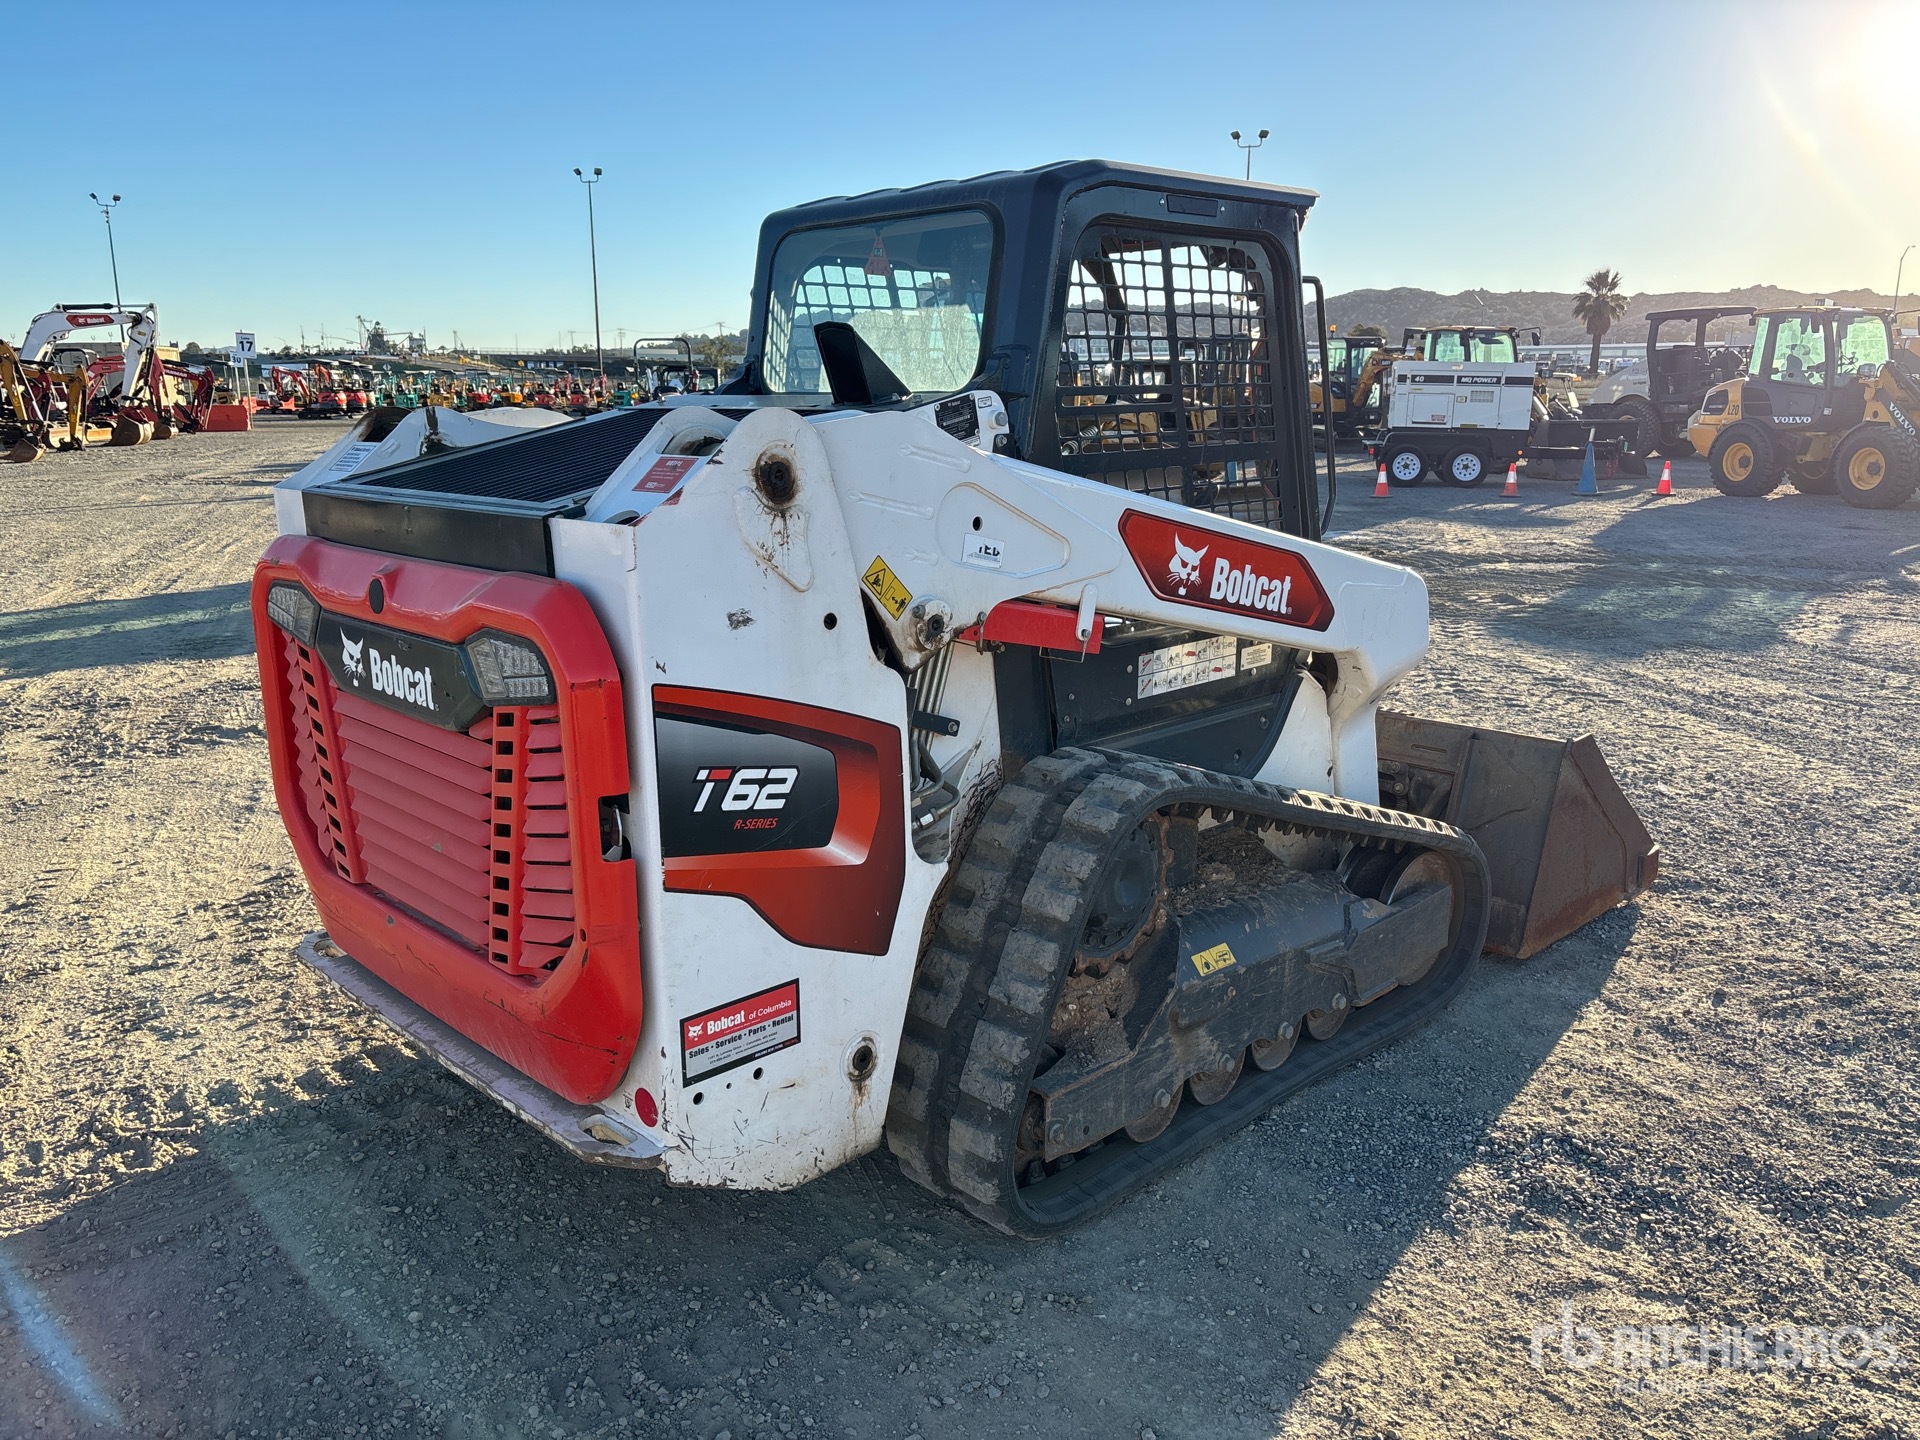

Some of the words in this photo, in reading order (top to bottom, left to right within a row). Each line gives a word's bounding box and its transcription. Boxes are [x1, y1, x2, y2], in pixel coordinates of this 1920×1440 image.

[239, 340, 253, 352] 17
[1727, 404, 1740, 416] L20
[1773, 416, 1812, 424] VOLVO
[1888, 401, 1916, 436] VOLVO
[1209, 557, 1292, 615] Bobcat
[368, 648, 435, 711] Bobcat
[693, 768, 799, 813] T62
[733, 818, 779, 830] R-SERIES
[706, 1009, 746, 1036] Bobcat
[748, 1011, 757, 1020] of
[757, 999, 792, 1017] Columbia
[688, 1045, 710, 1059] Sales
[715, 1033, 743, 1049] Service
[748, 1024, 767, 1037] Parts
[772, 1013, 794, 1028] Rental
